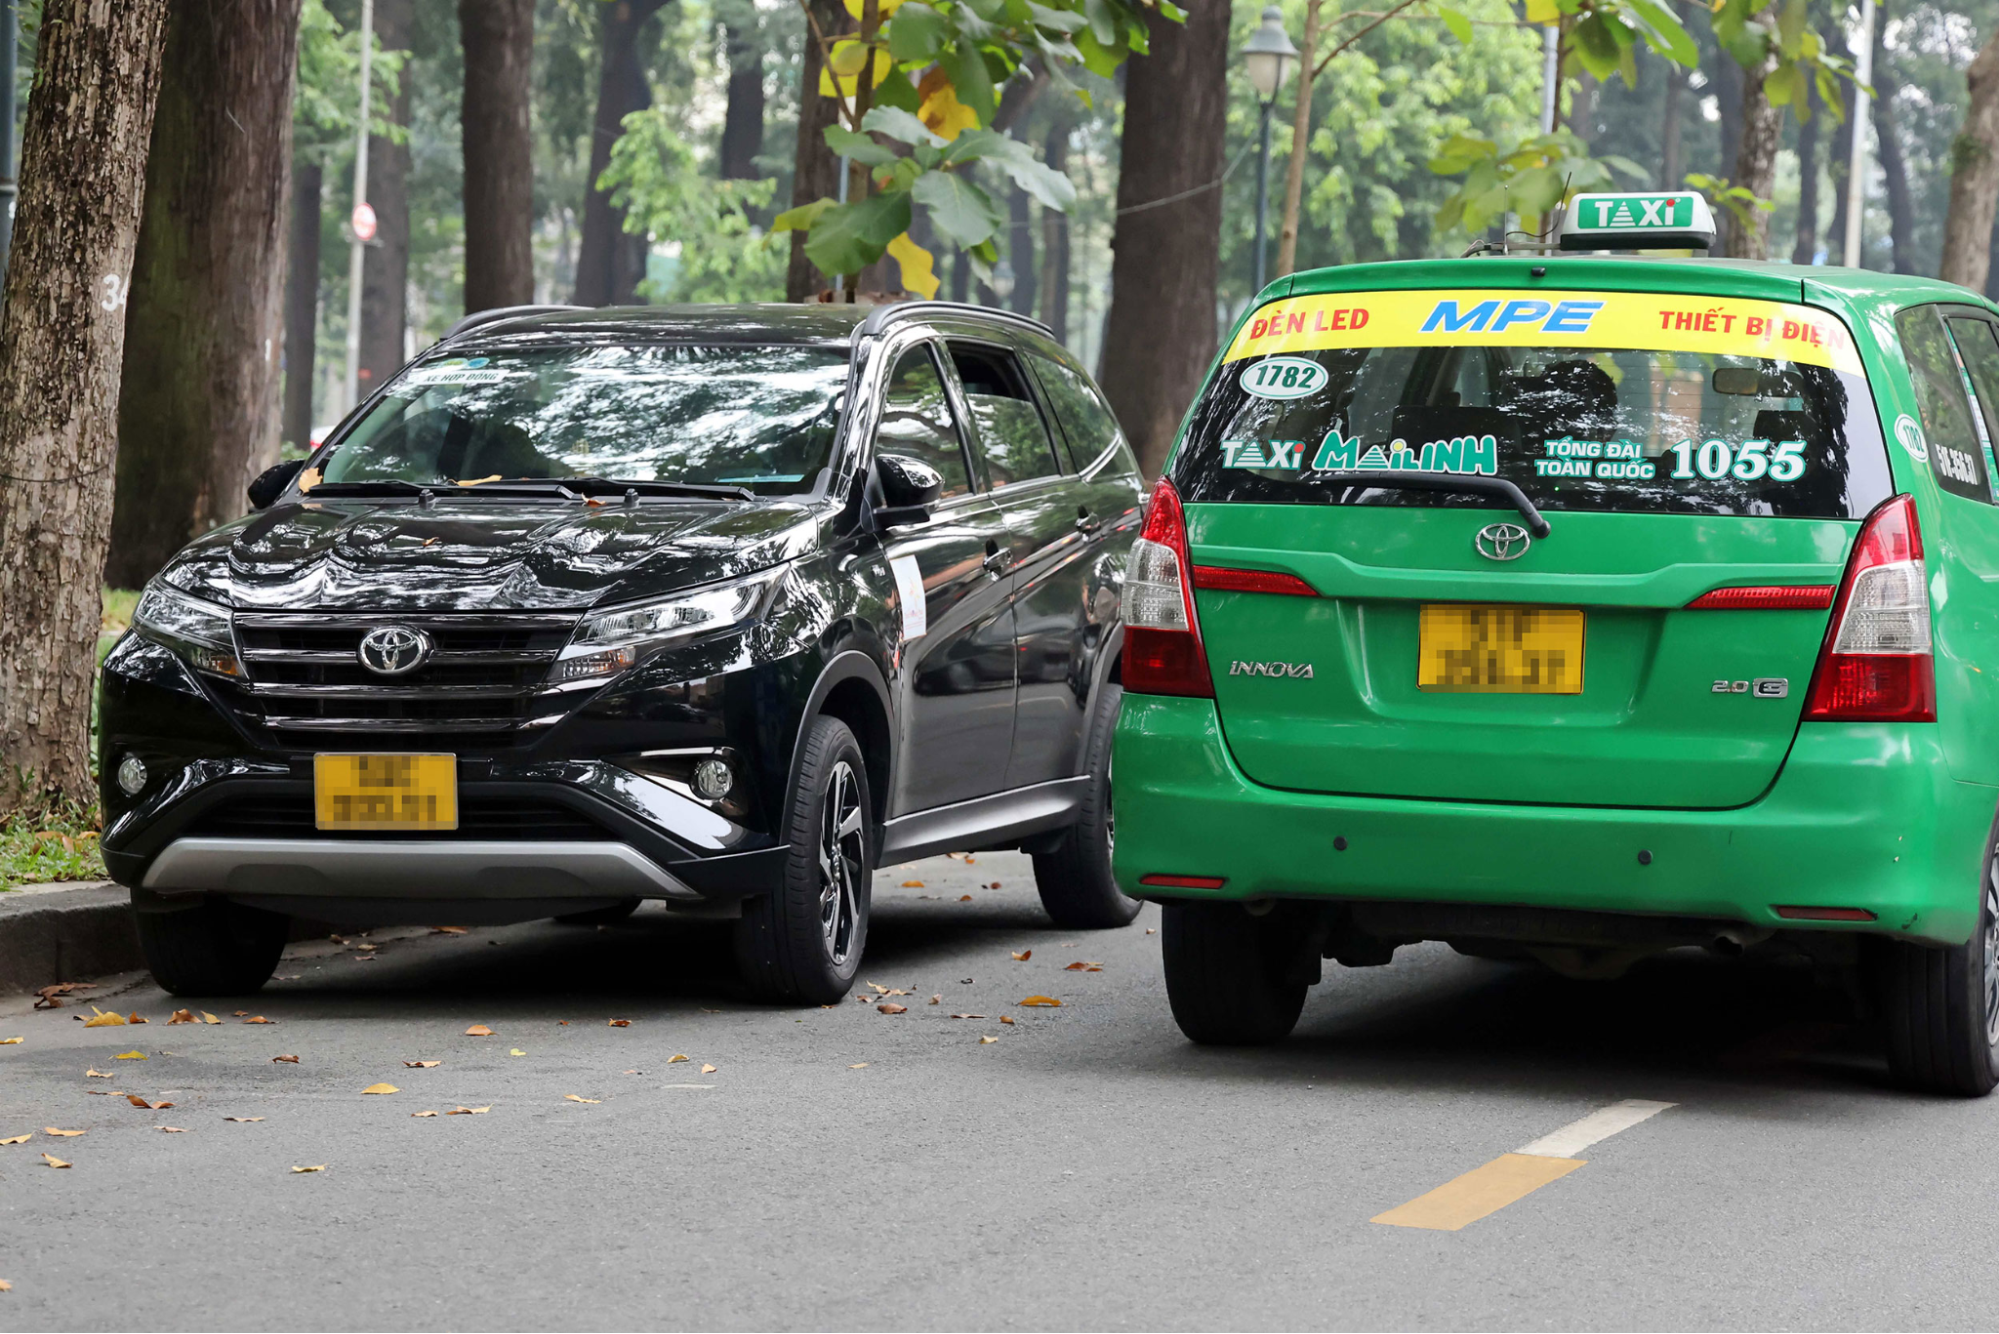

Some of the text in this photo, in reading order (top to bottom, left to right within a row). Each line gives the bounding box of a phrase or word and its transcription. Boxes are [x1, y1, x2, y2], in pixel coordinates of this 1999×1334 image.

[1249, 308, 1370, 340] ĐÈN LED
[1418, 300, 1605, 334] MPE
[1659, 307, 1845, 350] THIẾT BỊ ĐIỆN
[1255, 364, 1318, 390] 1782
[1605, 439, 1642, 460] ĐÀI
[1670, 438, 1807, 482] 1055
[1536, 456, 1655, 480] TOÀN QUỐC
[1711, 680, 1749, 693] 2.0
